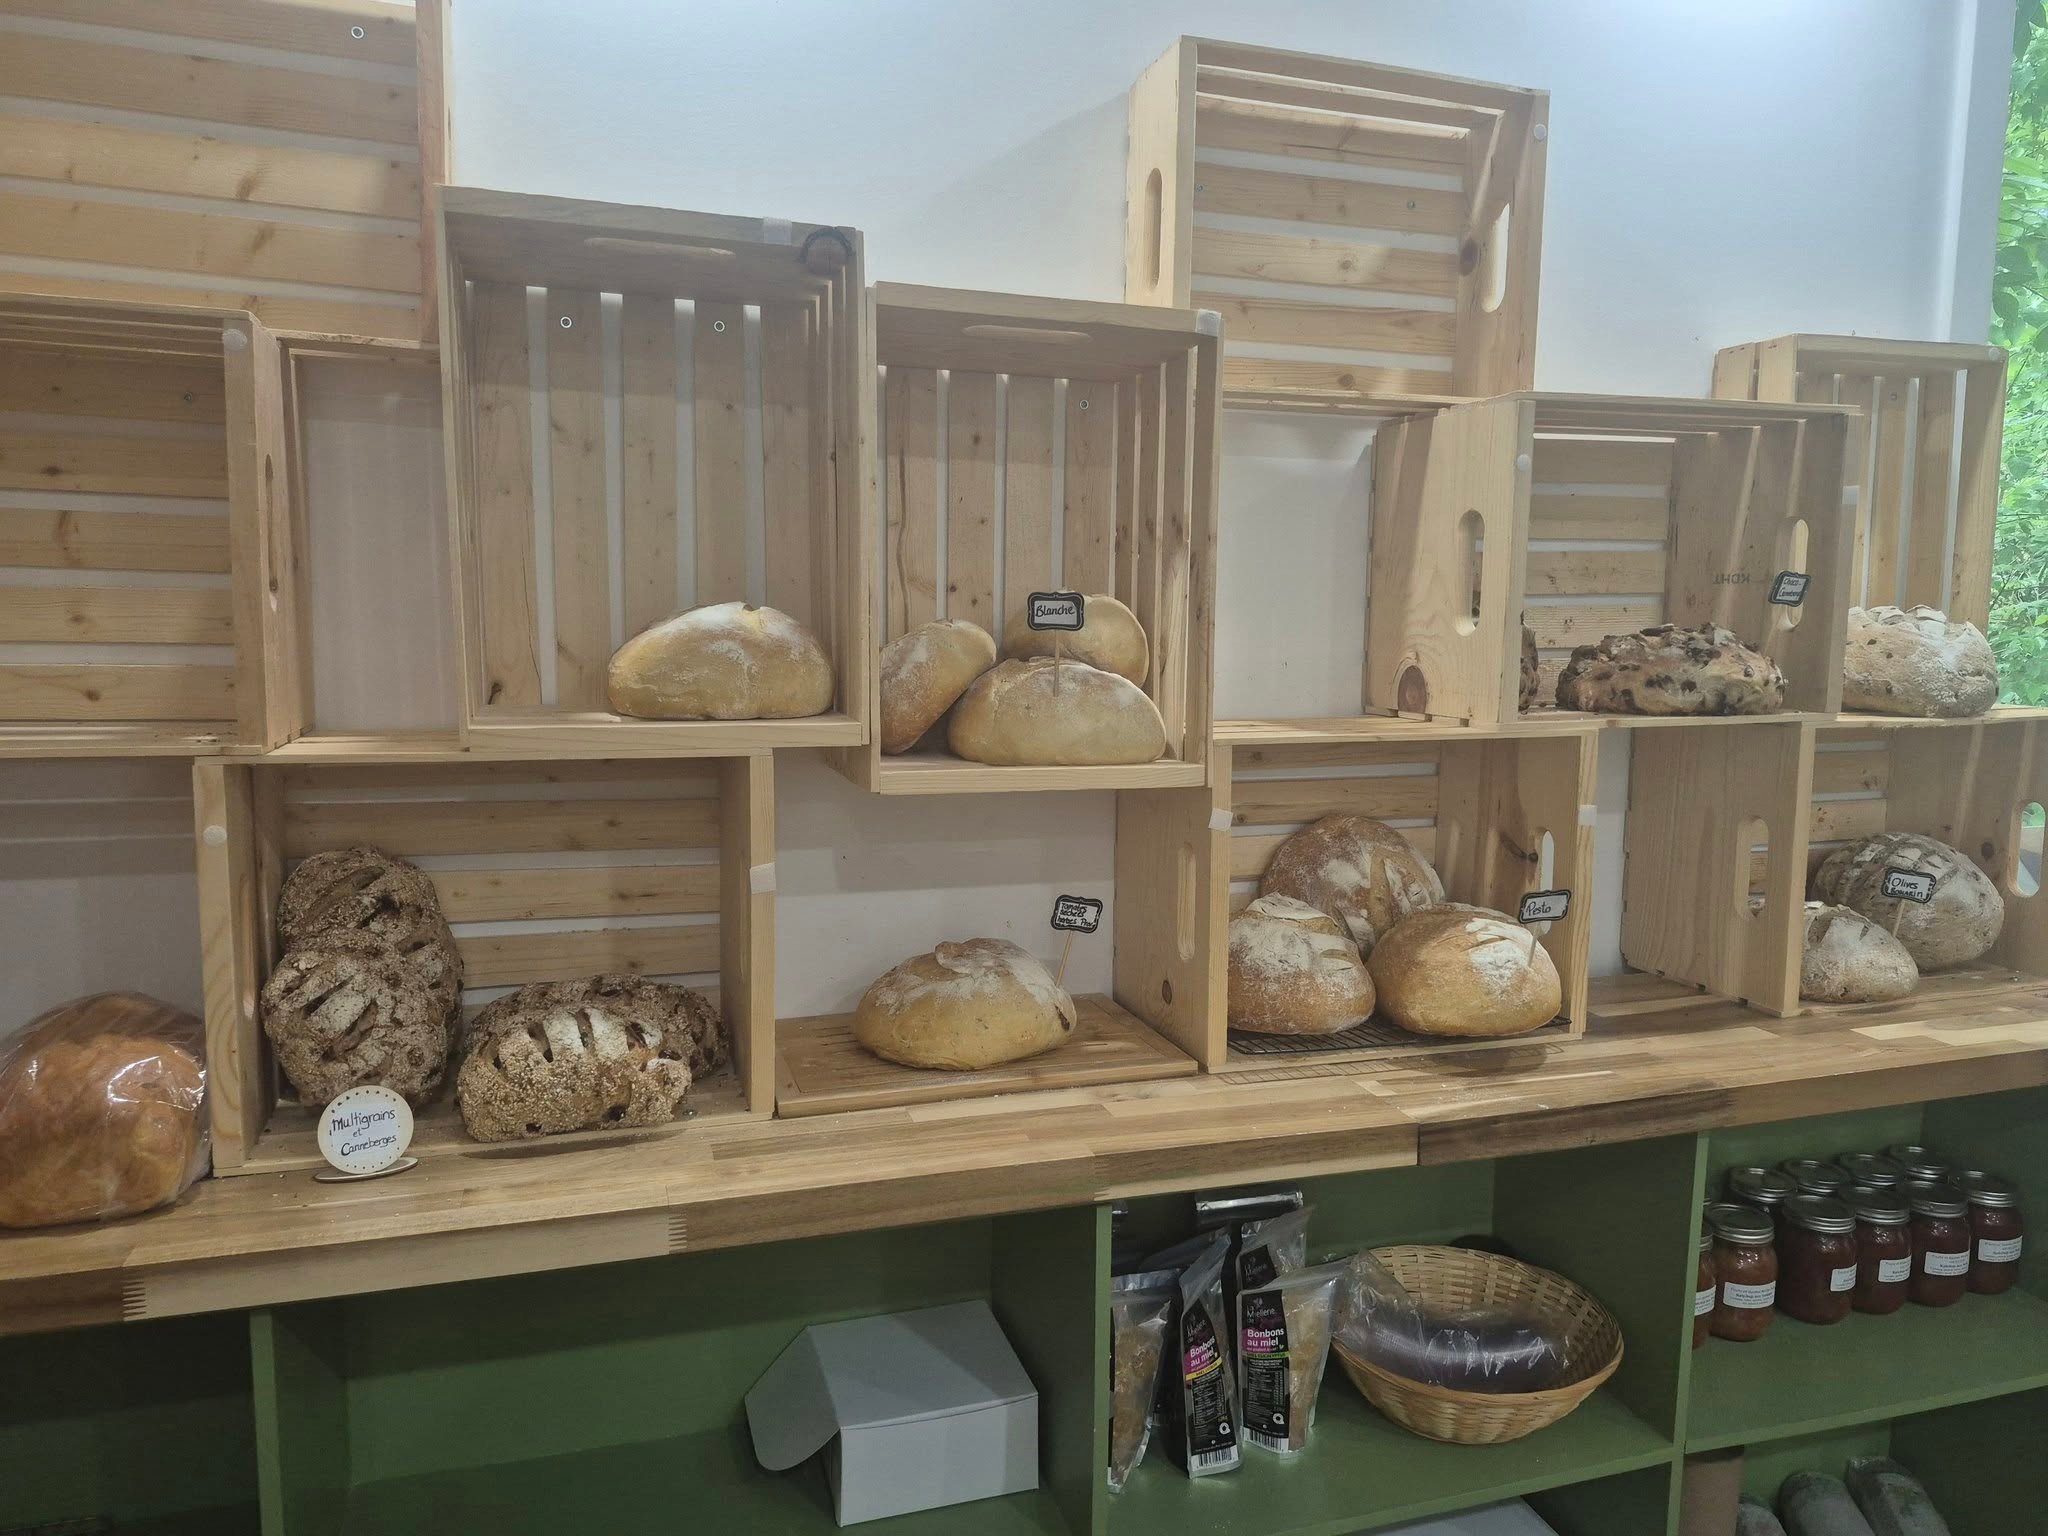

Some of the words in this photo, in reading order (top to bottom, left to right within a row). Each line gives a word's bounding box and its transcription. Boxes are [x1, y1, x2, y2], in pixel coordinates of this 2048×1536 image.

[1035, 604, 1076, 617] Blanche
[1892, 878, 1919, 889] Olives
[1526, 901, 1551, 916] Pesto
[332, 1110, 395, 1131] Multigrains
[353, 1128, 362, 1137] et
[341, 1135, 396, 1156] Canneberges
[1247, 1328, 1285, 1338] Bonbons
[1190, 1335, 1216, 1358] Bonbons
[1247, 1339, 1258, 1347] au
[1260, 1337, 1279, 1347] miel
[1190, 1357, 1200, 1367] au
[1200, 1346, 1214, 1362] miel
